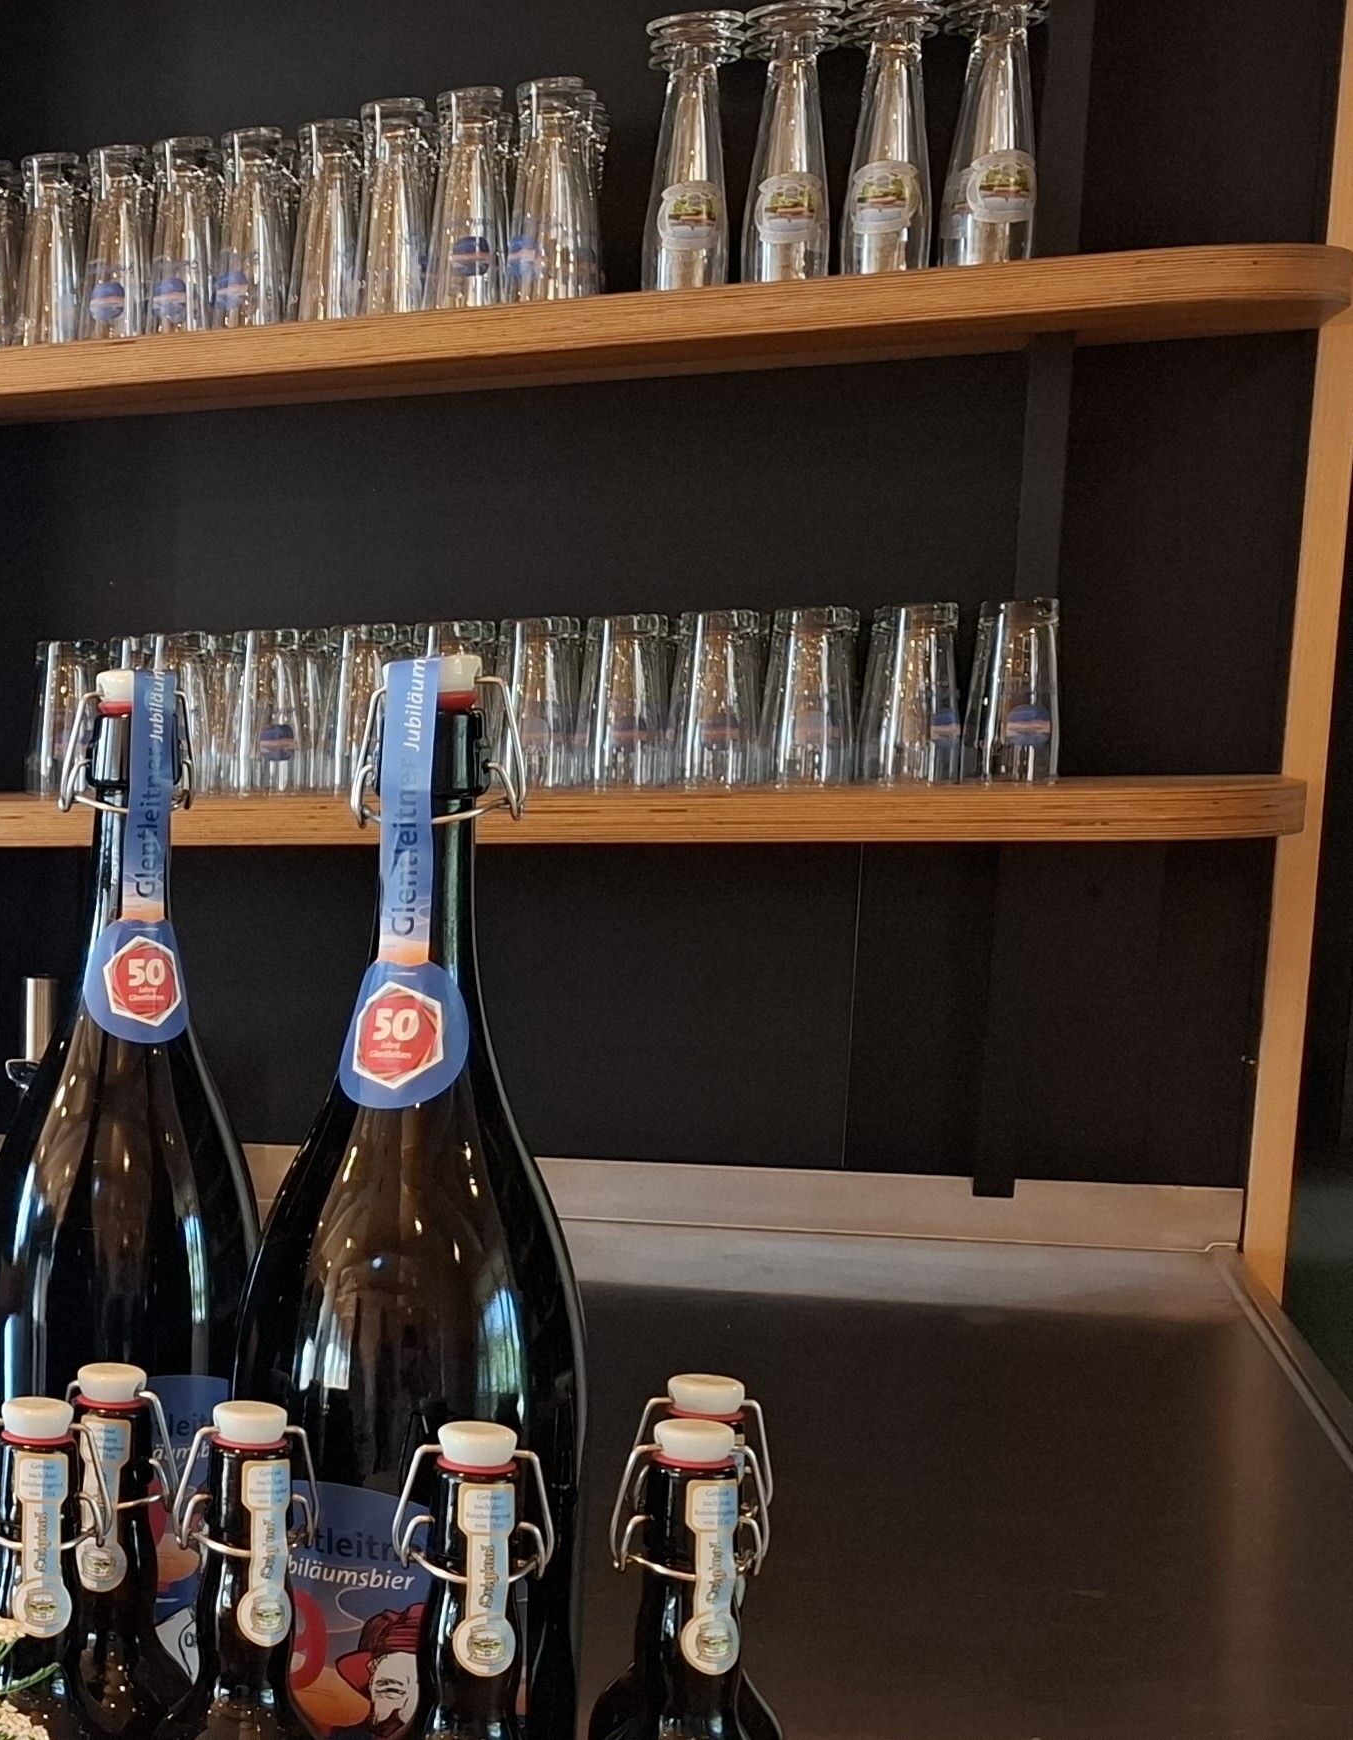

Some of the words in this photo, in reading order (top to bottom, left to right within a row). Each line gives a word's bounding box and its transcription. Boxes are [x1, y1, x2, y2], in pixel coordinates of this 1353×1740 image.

[127, 958, 166, 987] 50
[372, 1008, 420, 1041] 50
[287, 1554, 415, 1591] biläumsbier
